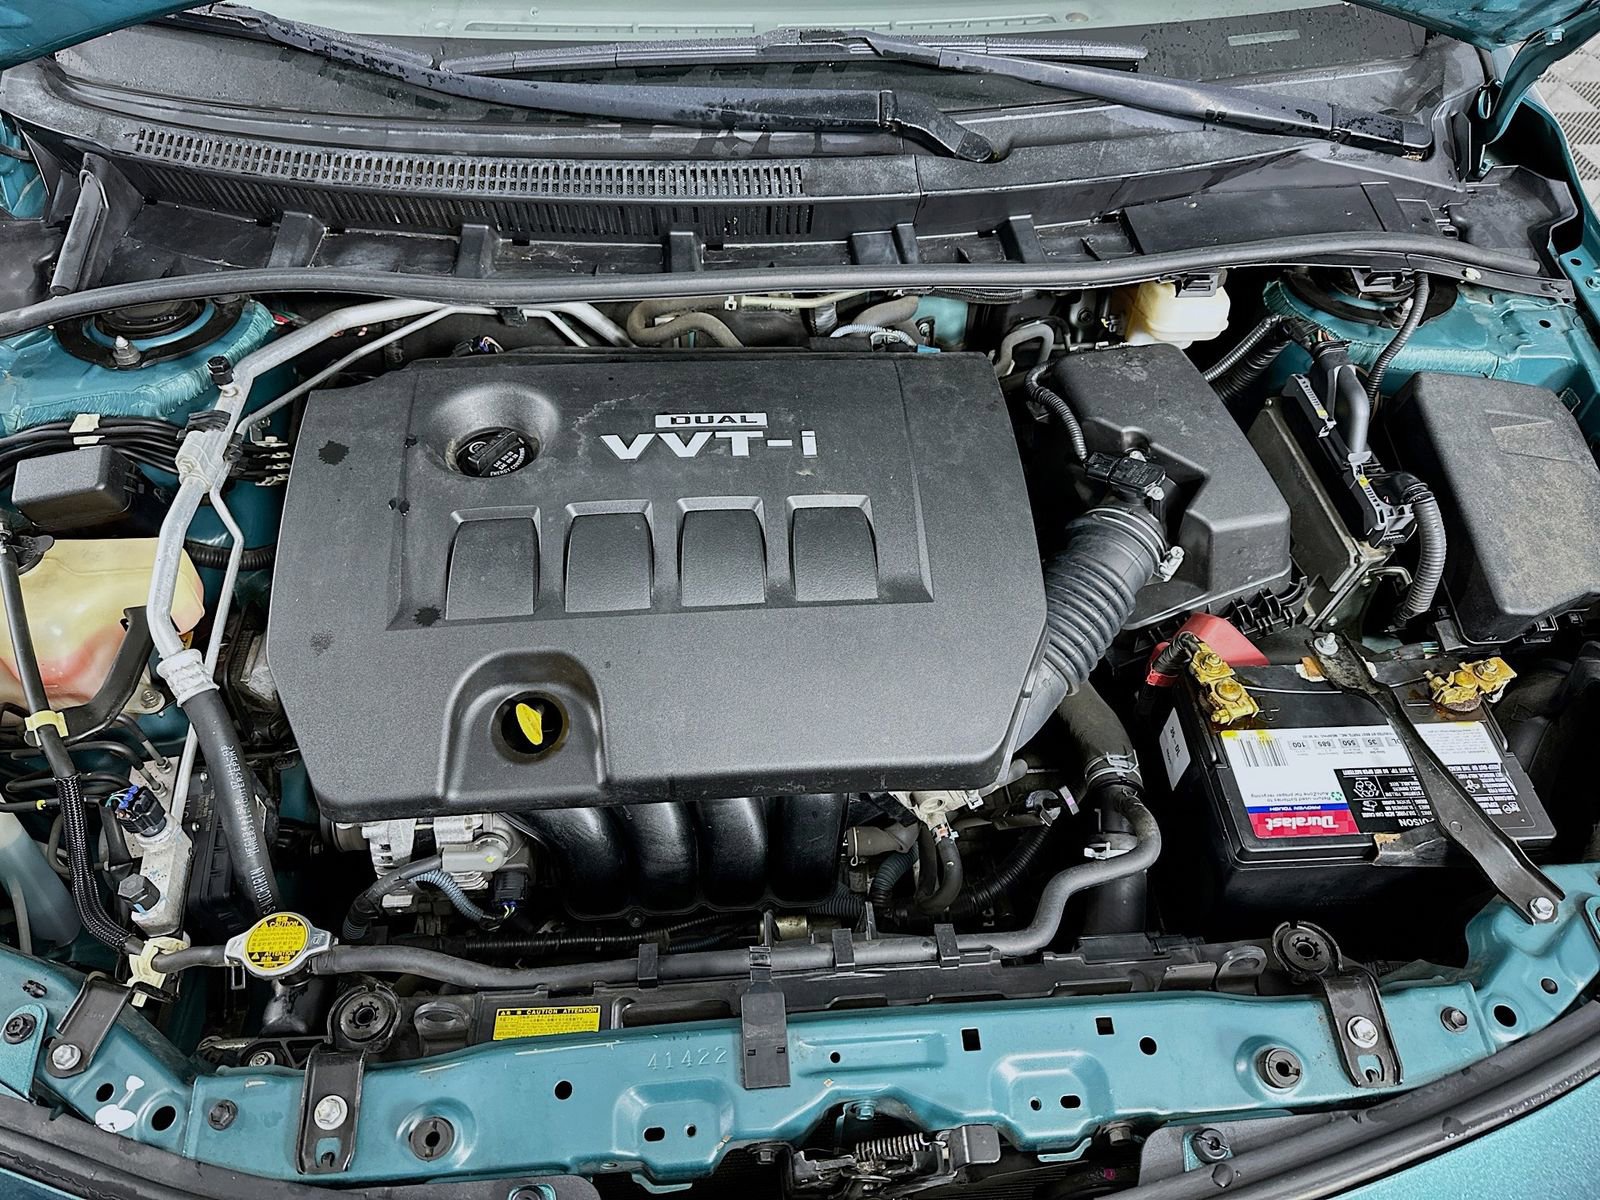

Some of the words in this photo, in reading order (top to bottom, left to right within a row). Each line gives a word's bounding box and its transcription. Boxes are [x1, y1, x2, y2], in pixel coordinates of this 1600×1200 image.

[670, 415, 758, 425] DUAL
[600, 430, 818, 459] VVT-i
[490, 468, 510, 476] ENERGY
[1264, 815, 1339, 830] Duralast
[647, 1046, 728, 1070] 41422
